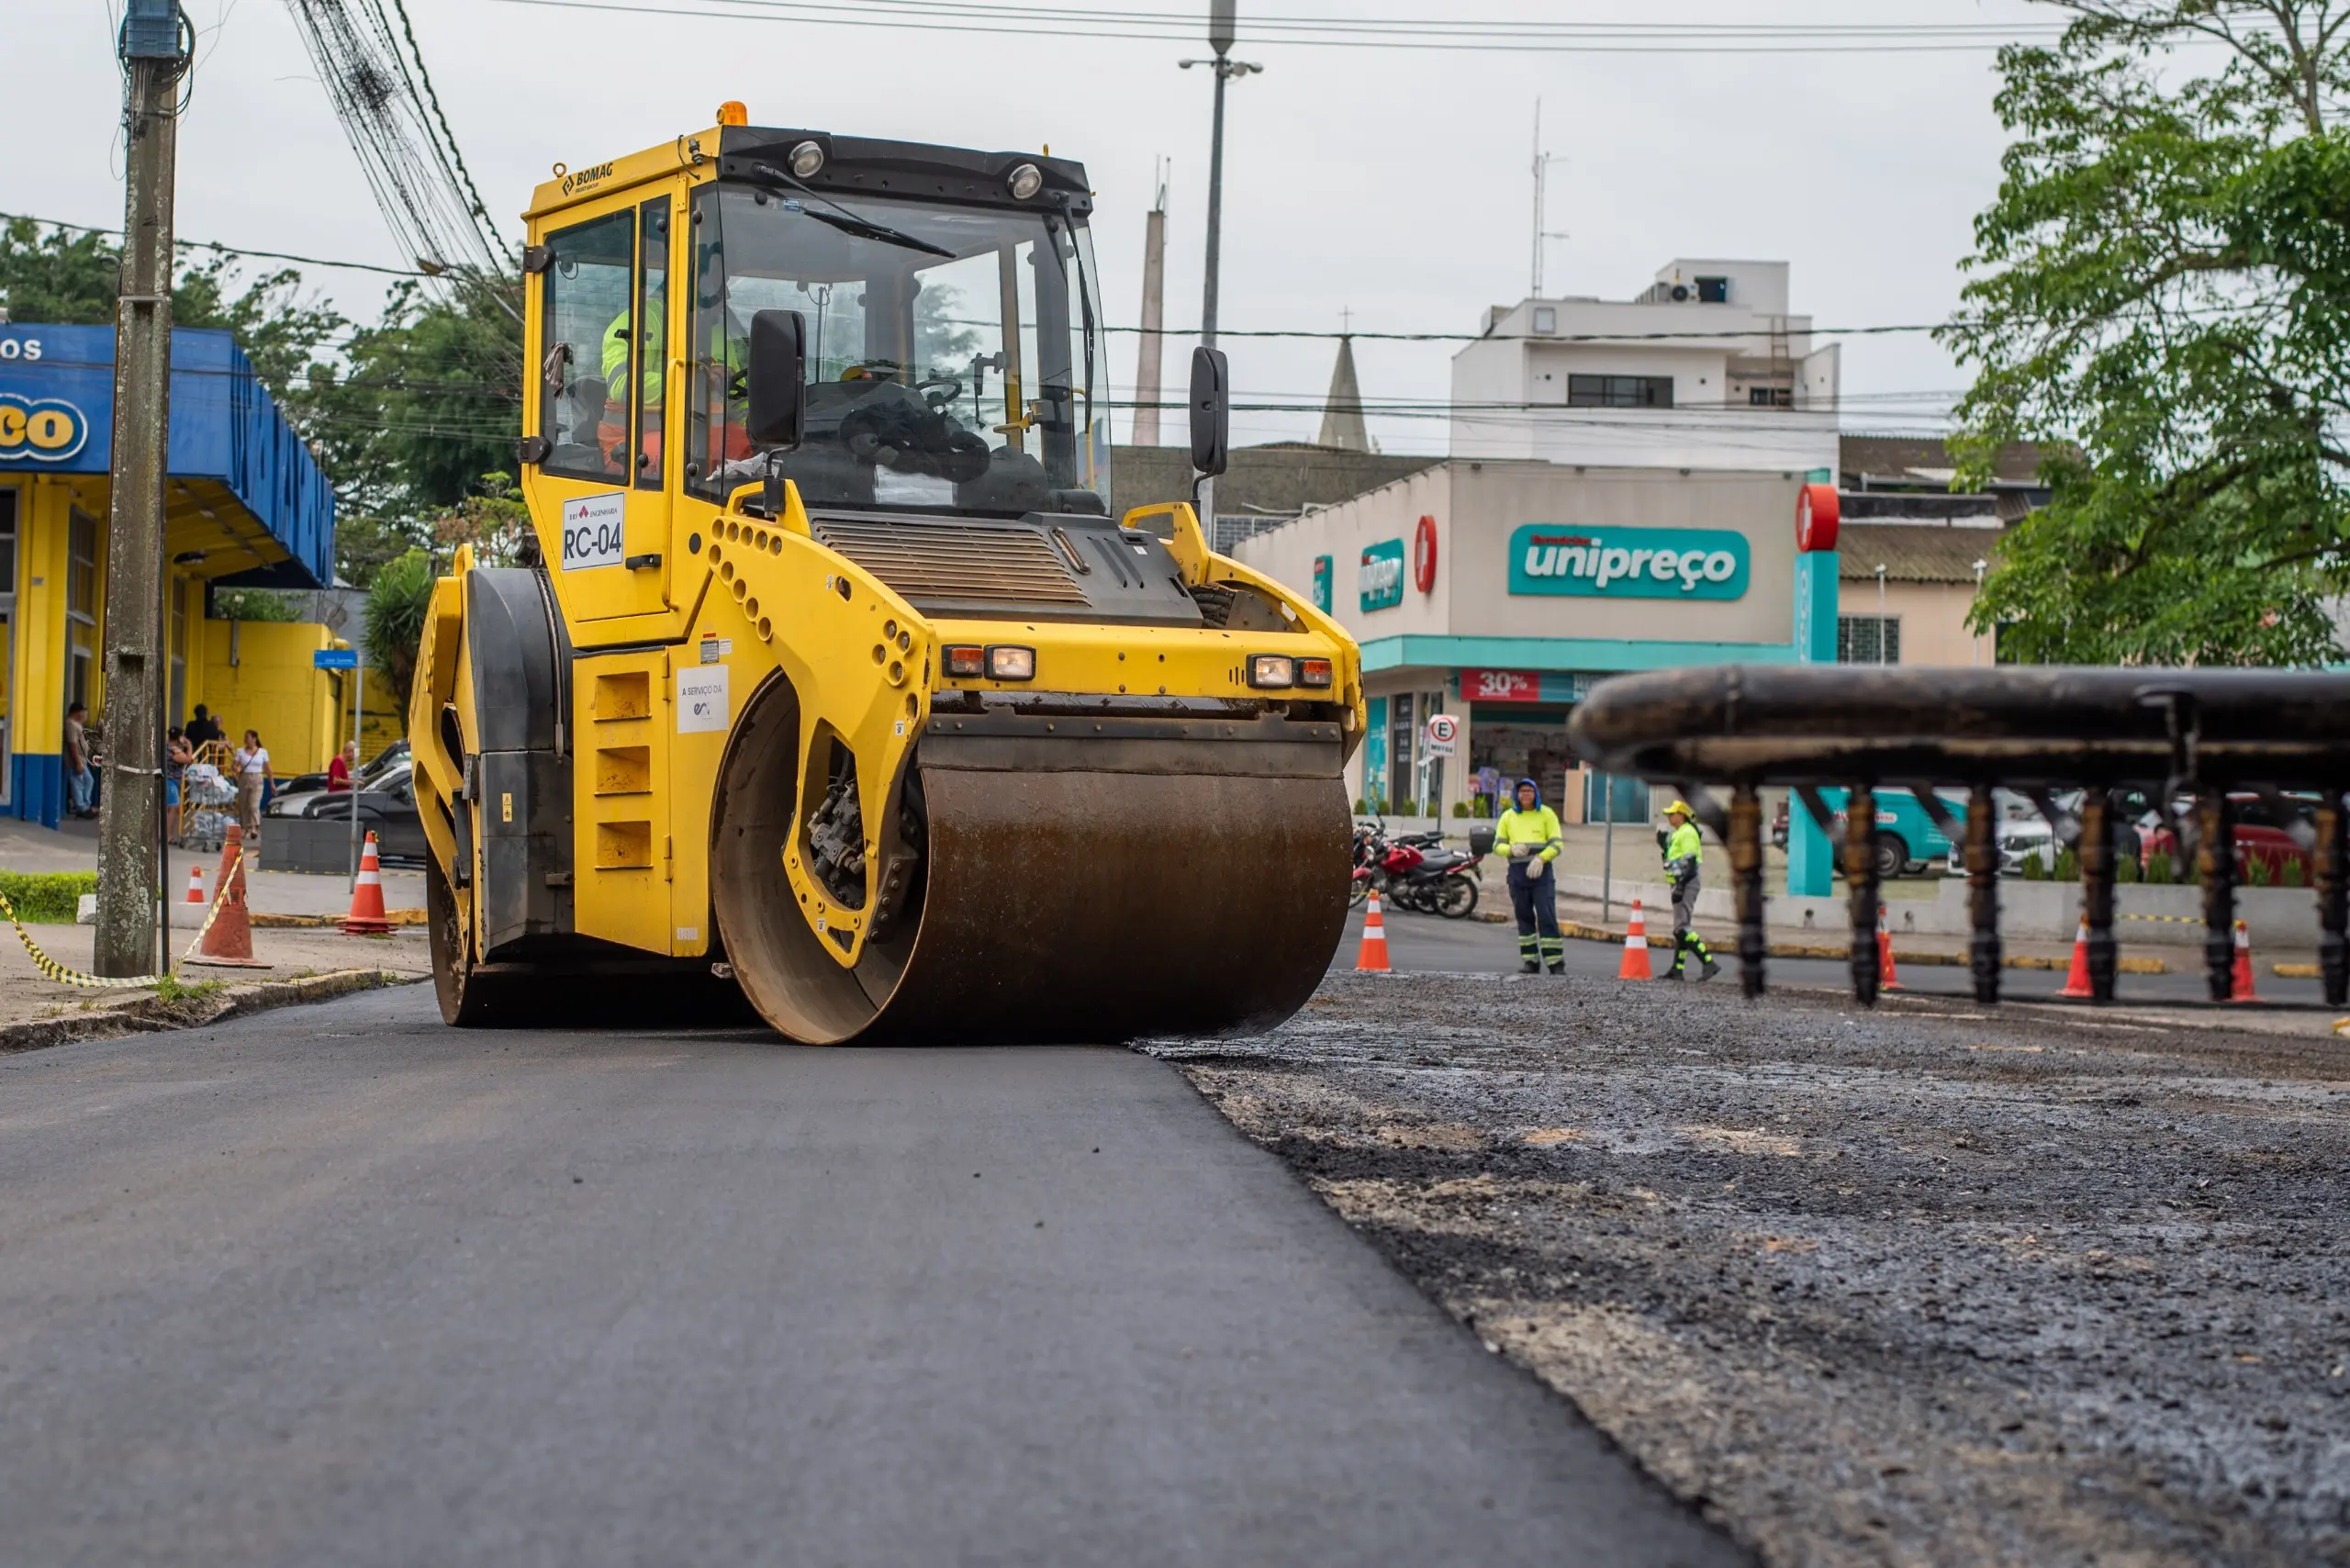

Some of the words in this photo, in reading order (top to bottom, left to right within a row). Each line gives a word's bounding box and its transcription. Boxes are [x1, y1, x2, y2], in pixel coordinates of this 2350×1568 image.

[576, 162, 613, 186] BOMAG
[589, 507, 618, 518] ENGENHARIA
[564, 521, 621, 560] RC-04
[1525, 537, 1737, 591] unipreço
[688, 685, 712, 697] SERVIÇO
[713, 684, 722, 694] DA
[1479, 671, 1528, 693] 30%
[1438, 722, 1449, 737] E
